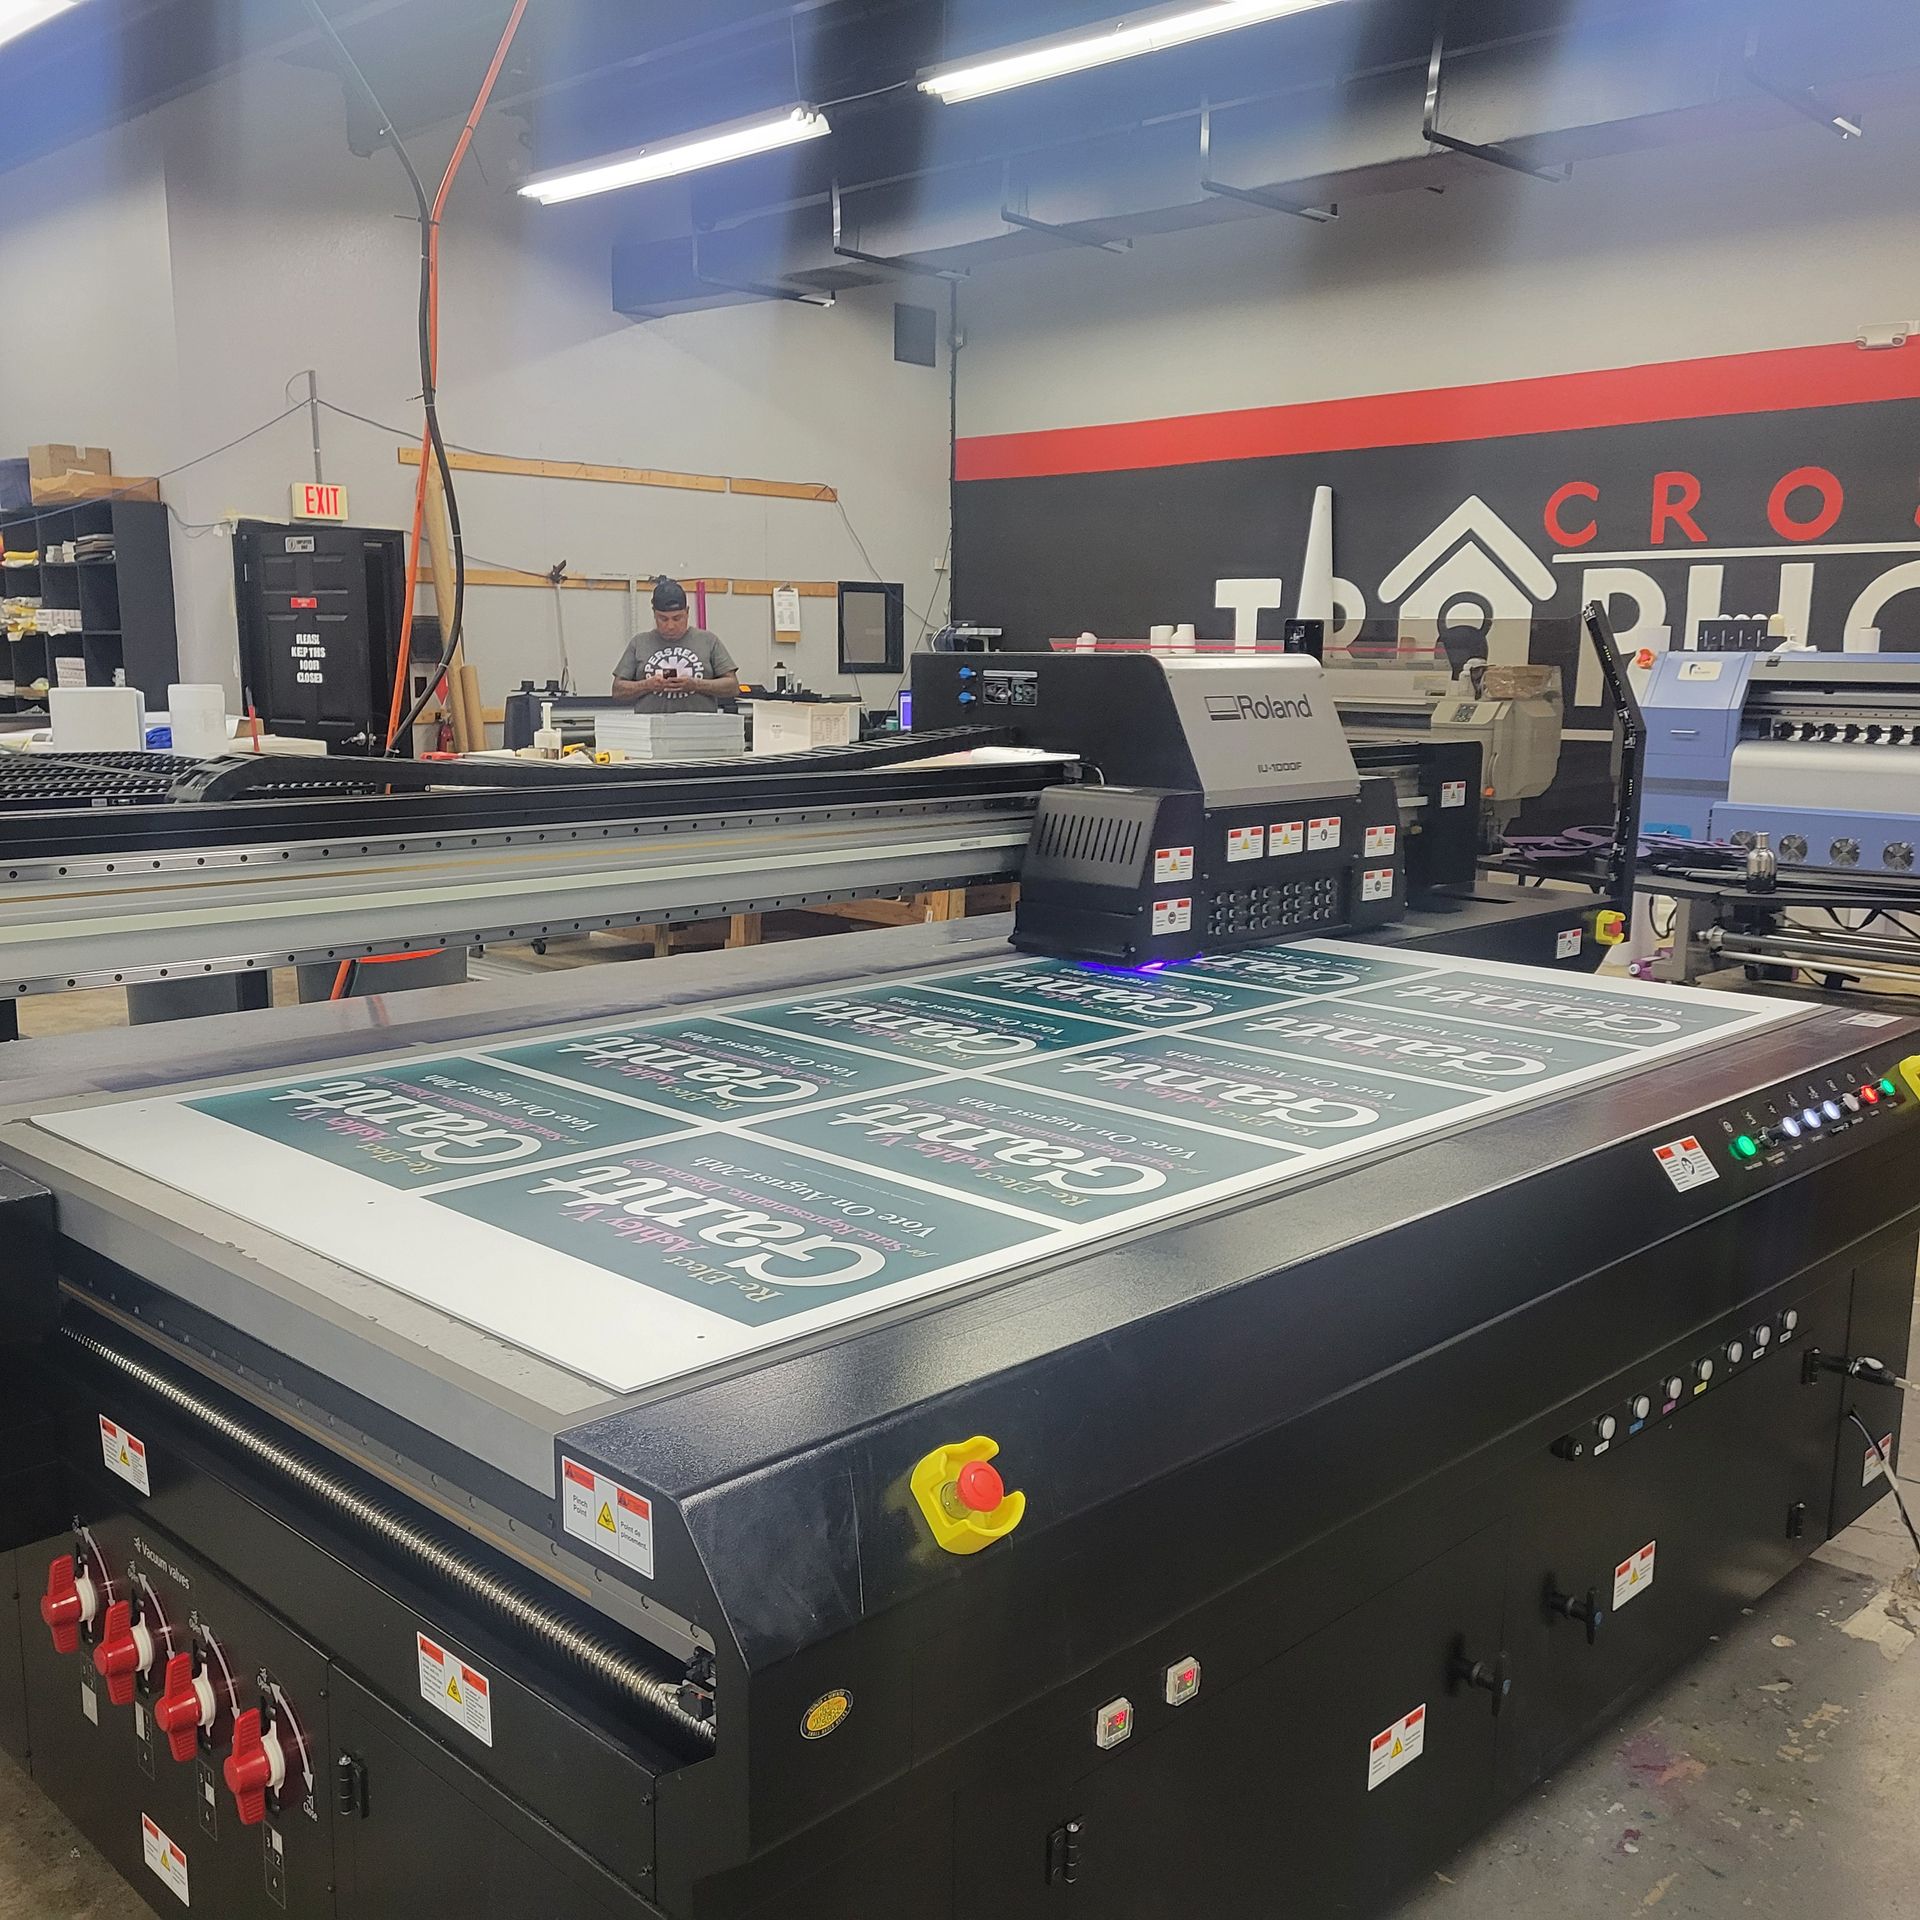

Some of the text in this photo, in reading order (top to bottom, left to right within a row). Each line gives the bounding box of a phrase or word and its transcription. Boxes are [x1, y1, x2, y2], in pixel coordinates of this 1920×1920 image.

[305, 486, 340, 515] EXIT
[1544, 466, 1920, 547] CRO
[673, 647, 699, 663] RED
[296, 671, 323, 684] CLOSED
[1237, 693, 1313, 720] Roland
[1257, 761, 1303, 773] IU-1000F
[1191, 954, 1360, 985] Gan
[972, 971, 1212, 1016] Gantt
[1392, 985, 1680, 1033] Gantt
[785, 1000, 1036, 1054] Gantt
[1023, 1023, 1063, 1034] Vote
[1462, 1034, 1498, 1042] On
[678, 1031, 857, 1077] Vote On August 20th
[1243, 1017, 1545, 1075] Gantt
[1504, 1041, 1552, 1053] Vote
[556, 1036, 818, 1102] Gantt
[611, 1064, 690, 1084] Ashley
[1165, 1050, 1394, 1099] Vote On August 20th
[419, 1074, 598, 1131] Vote On August 20th
[1058, 1055, 1378, 1127] Gantt
[269, 1080, 541, 1163] Gantt
[319, 1116, 399, 1140] Ashley
[956, 1097, 1195, 1159] Vote On August 20th
[355, 1143, 441, 1174] Re-Elect
[622, 1158, 666, 1170] 109
[827, 1103, 1166, 1194] Gantt
[865, 1133, 1008, 1169] Ashley V.
[658, 1167, 727, 1191] District
[690, 1156, 750, 1175] 20th
[743, 1172, 836, 1200] August
[975, 1171, 1092, 1206] Re-Elect
[831, 1198, 875, 1215] On
[527, 1165, 885, 1286] Gantt
[559, 1205, 707, 1252] Ashley V.
[857, 1230, 910, 1250] State
[877, 1213, 935, 1237] Vote
[662, 1255, 783, 1302] Re-Elect
[573, 1494, 588, 1508] Pinch
[573, 1504, 587, 1517] Point
[620, 1521, 634, 1533] Point
[141, 1541, 190, 1590] Vacuum valves
